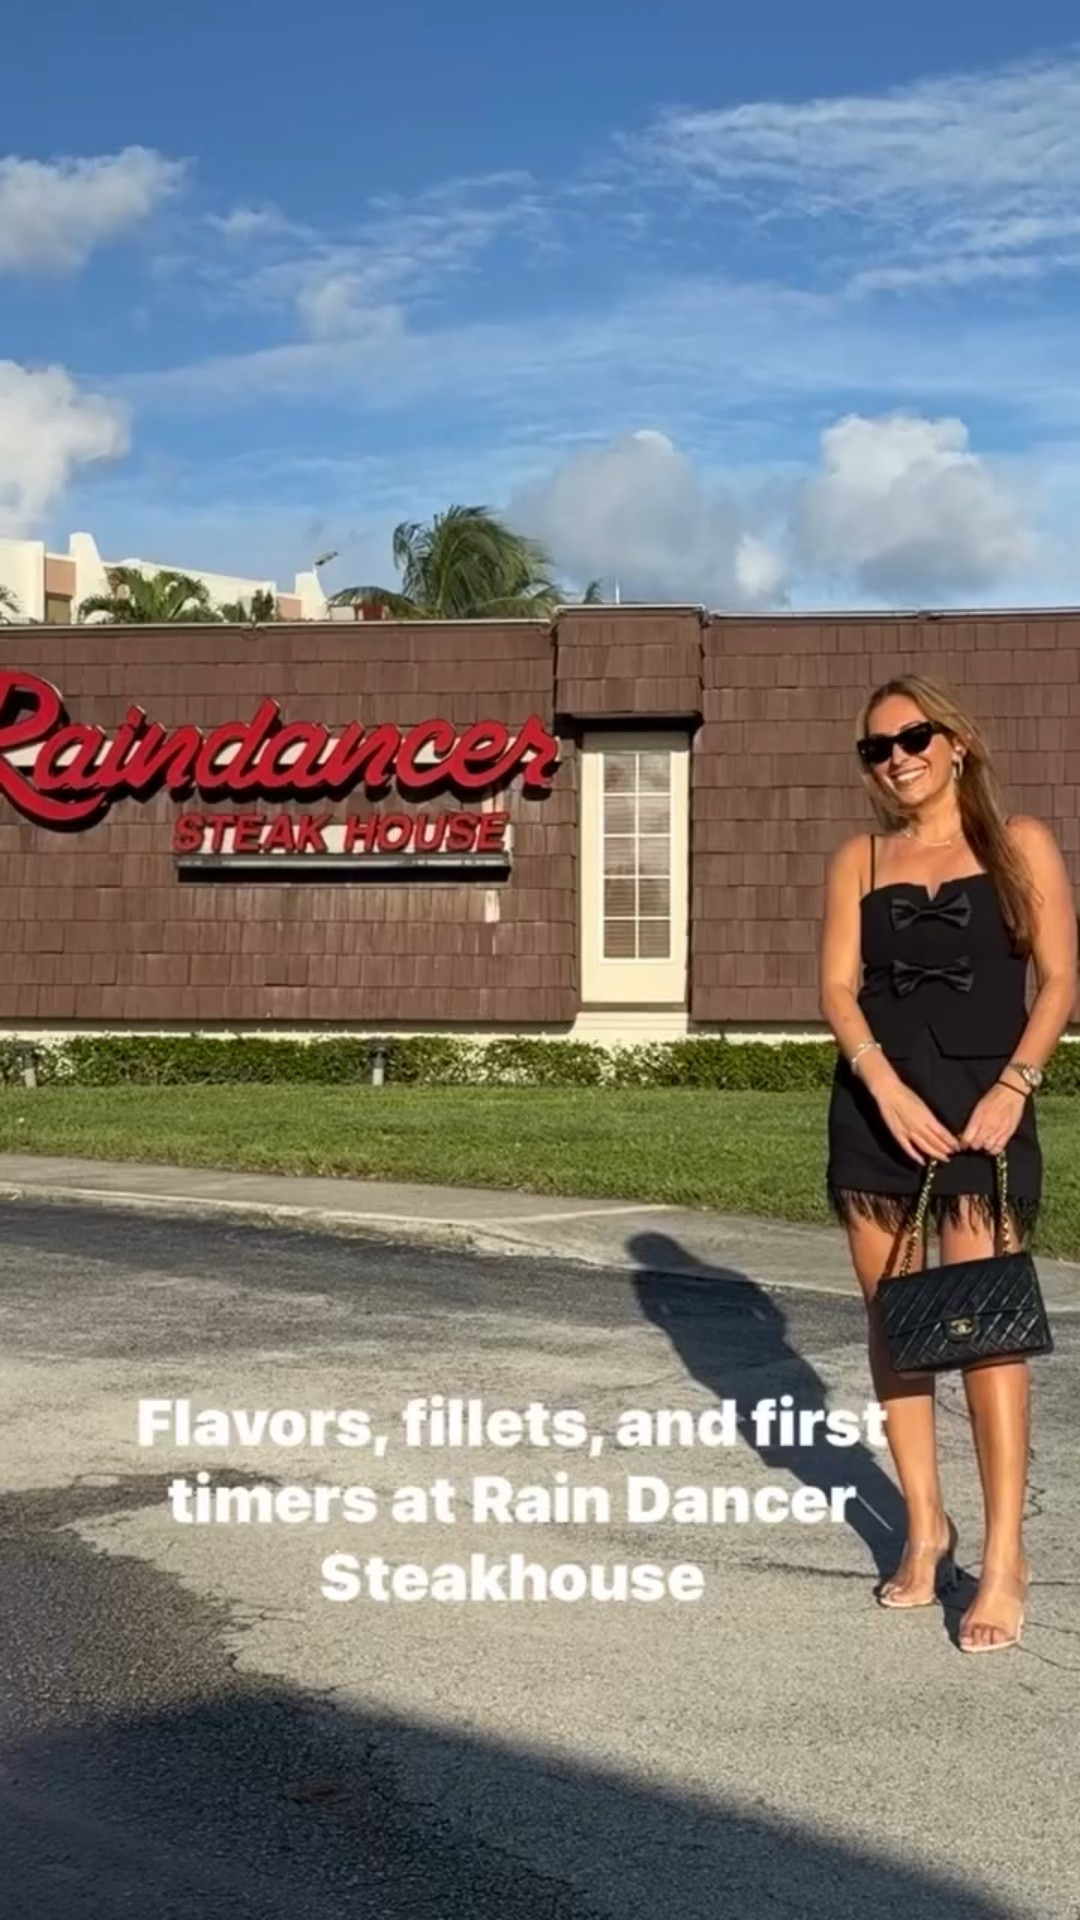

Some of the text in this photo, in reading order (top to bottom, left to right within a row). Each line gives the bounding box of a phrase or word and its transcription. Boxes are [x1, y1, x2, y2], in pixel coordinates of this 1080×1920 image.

[0, 670, 559, 821] Raindancer
[172, 811, 510, 852] STEAK HOUSE
